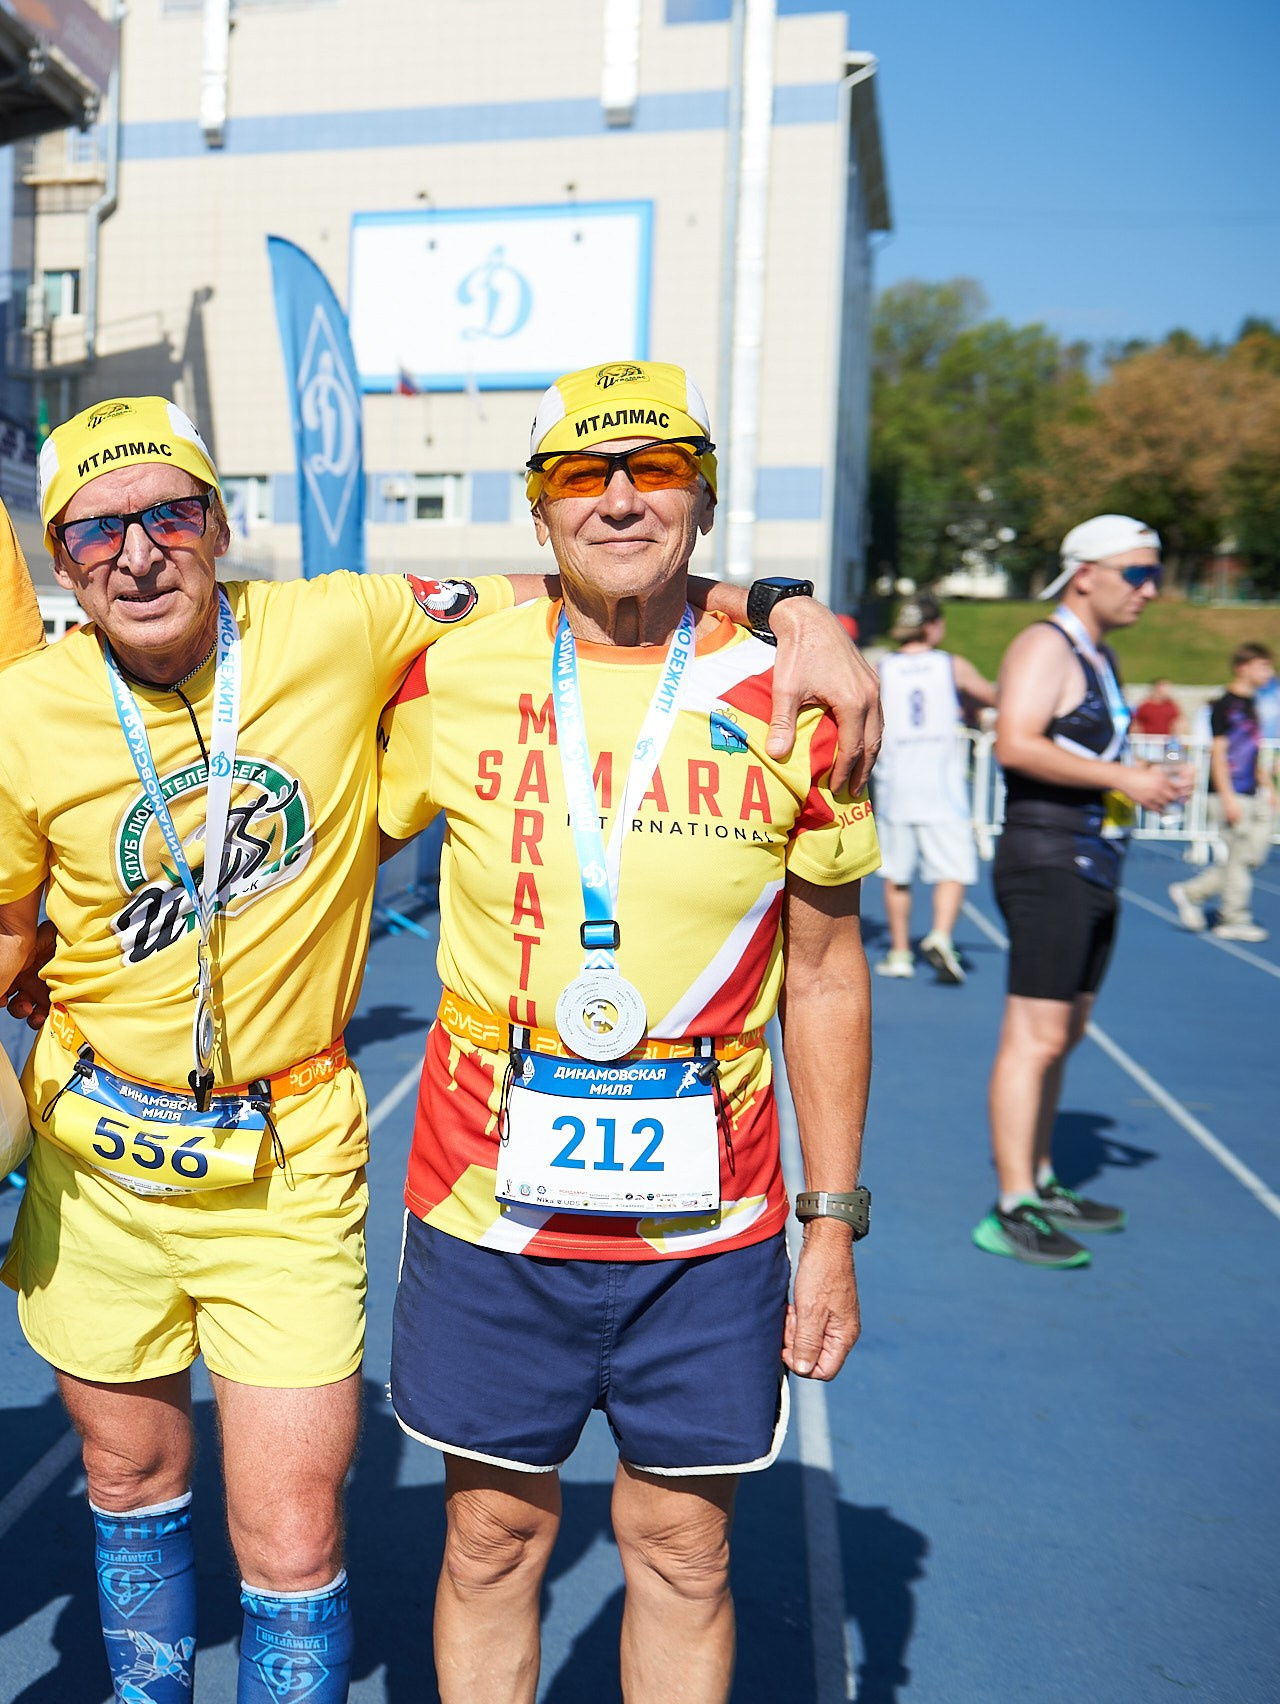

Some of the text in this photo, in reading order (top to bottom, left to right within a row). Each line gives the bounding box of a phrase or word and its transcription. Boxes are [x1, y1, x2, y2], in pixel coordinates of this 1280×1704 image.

[575, 409, 670, 437] ИТАЛМАС
[77, 442, 172, 477] ИТАЛМАС
[558, 628, 574, 676] МИЛЯ
[655, 647, 688, 714] БЕЖИТ!
[123, 713, 185, 864] ДИНАМОВСКАЯ
[128, 767, 209, 836] ЛЮТЕЛЕ
[567, 813, 775, 844] ITRNATIONAL
[124, 838, 142, 882] КЛУБ
[553, 1065, 667, 1082] ДИНАМОВСКАЯ
[588, 1082, 633, 1097] МИЛЯ
[119, 1085, 217, 1112] ДИНАМОВСК
[142, 1107, 182, 1121] МИЛЯ
[92, 1116, 208, 1179] 556
[549, 1115, 665, 1172] 212
